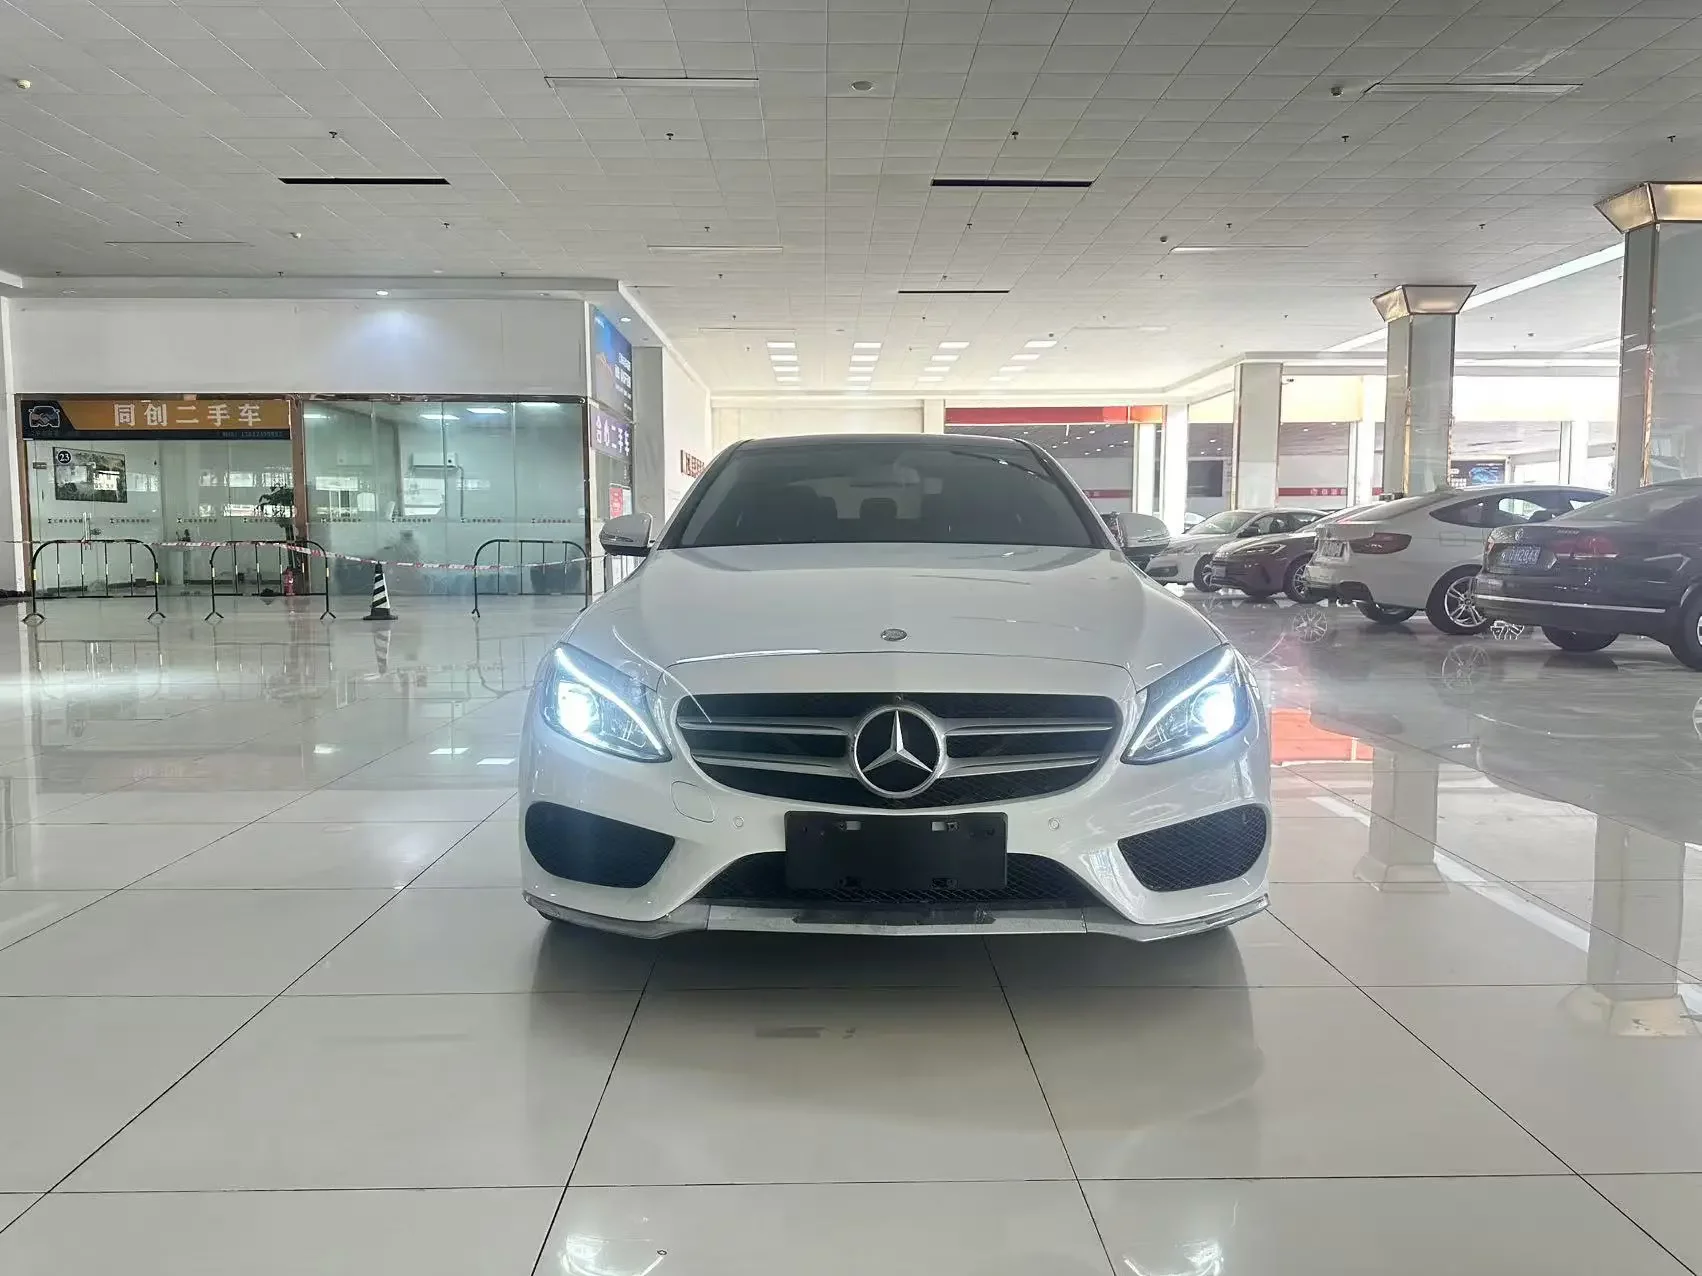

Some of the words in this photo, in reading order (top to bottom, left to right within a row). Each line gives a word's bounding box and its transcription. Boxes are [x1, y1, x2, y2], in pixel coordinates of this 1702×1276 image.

[114, 403, 261, 427] 同创二手车
[59, 453, 70, 462] 23
